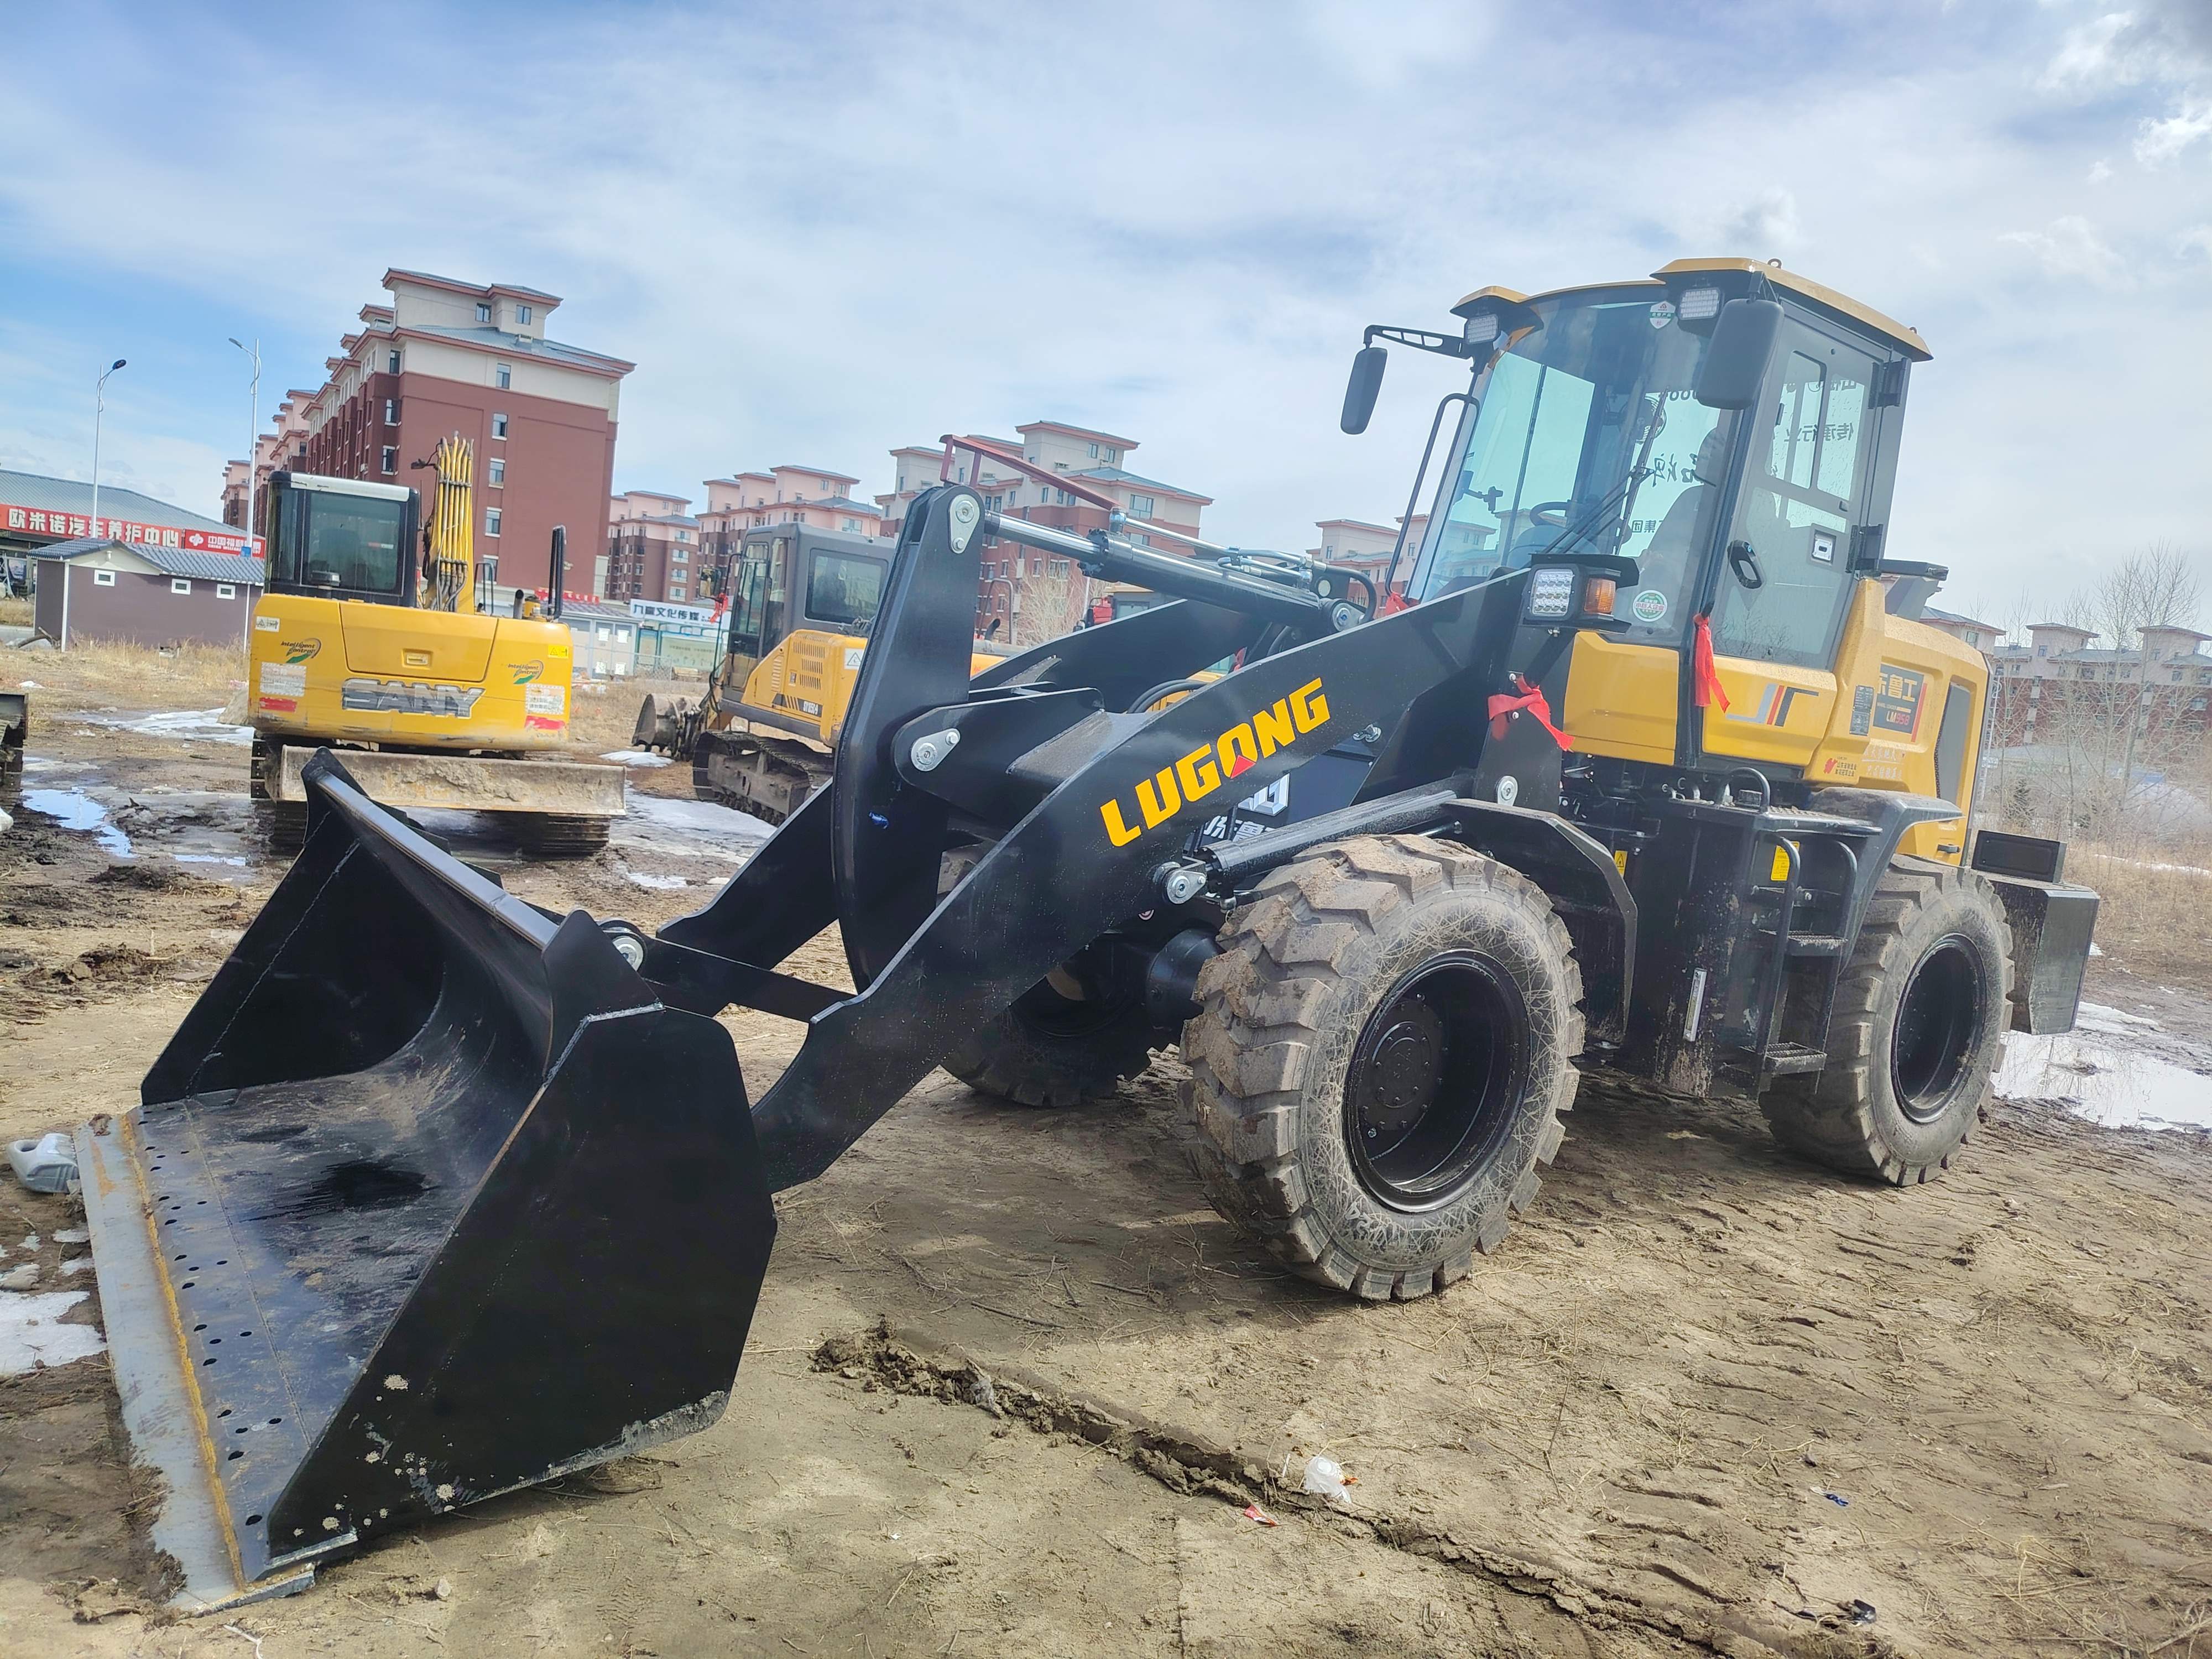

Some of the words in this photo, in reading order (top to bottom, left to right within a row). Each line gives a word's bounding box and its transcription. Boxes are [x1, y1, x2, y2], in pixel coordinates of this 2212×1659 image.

[8, 508, 179, 547] 欧米诺汽车养护中心
[342, 678, 486, 718] SANY
[1100, 677, 1331, 847] LUGONG
